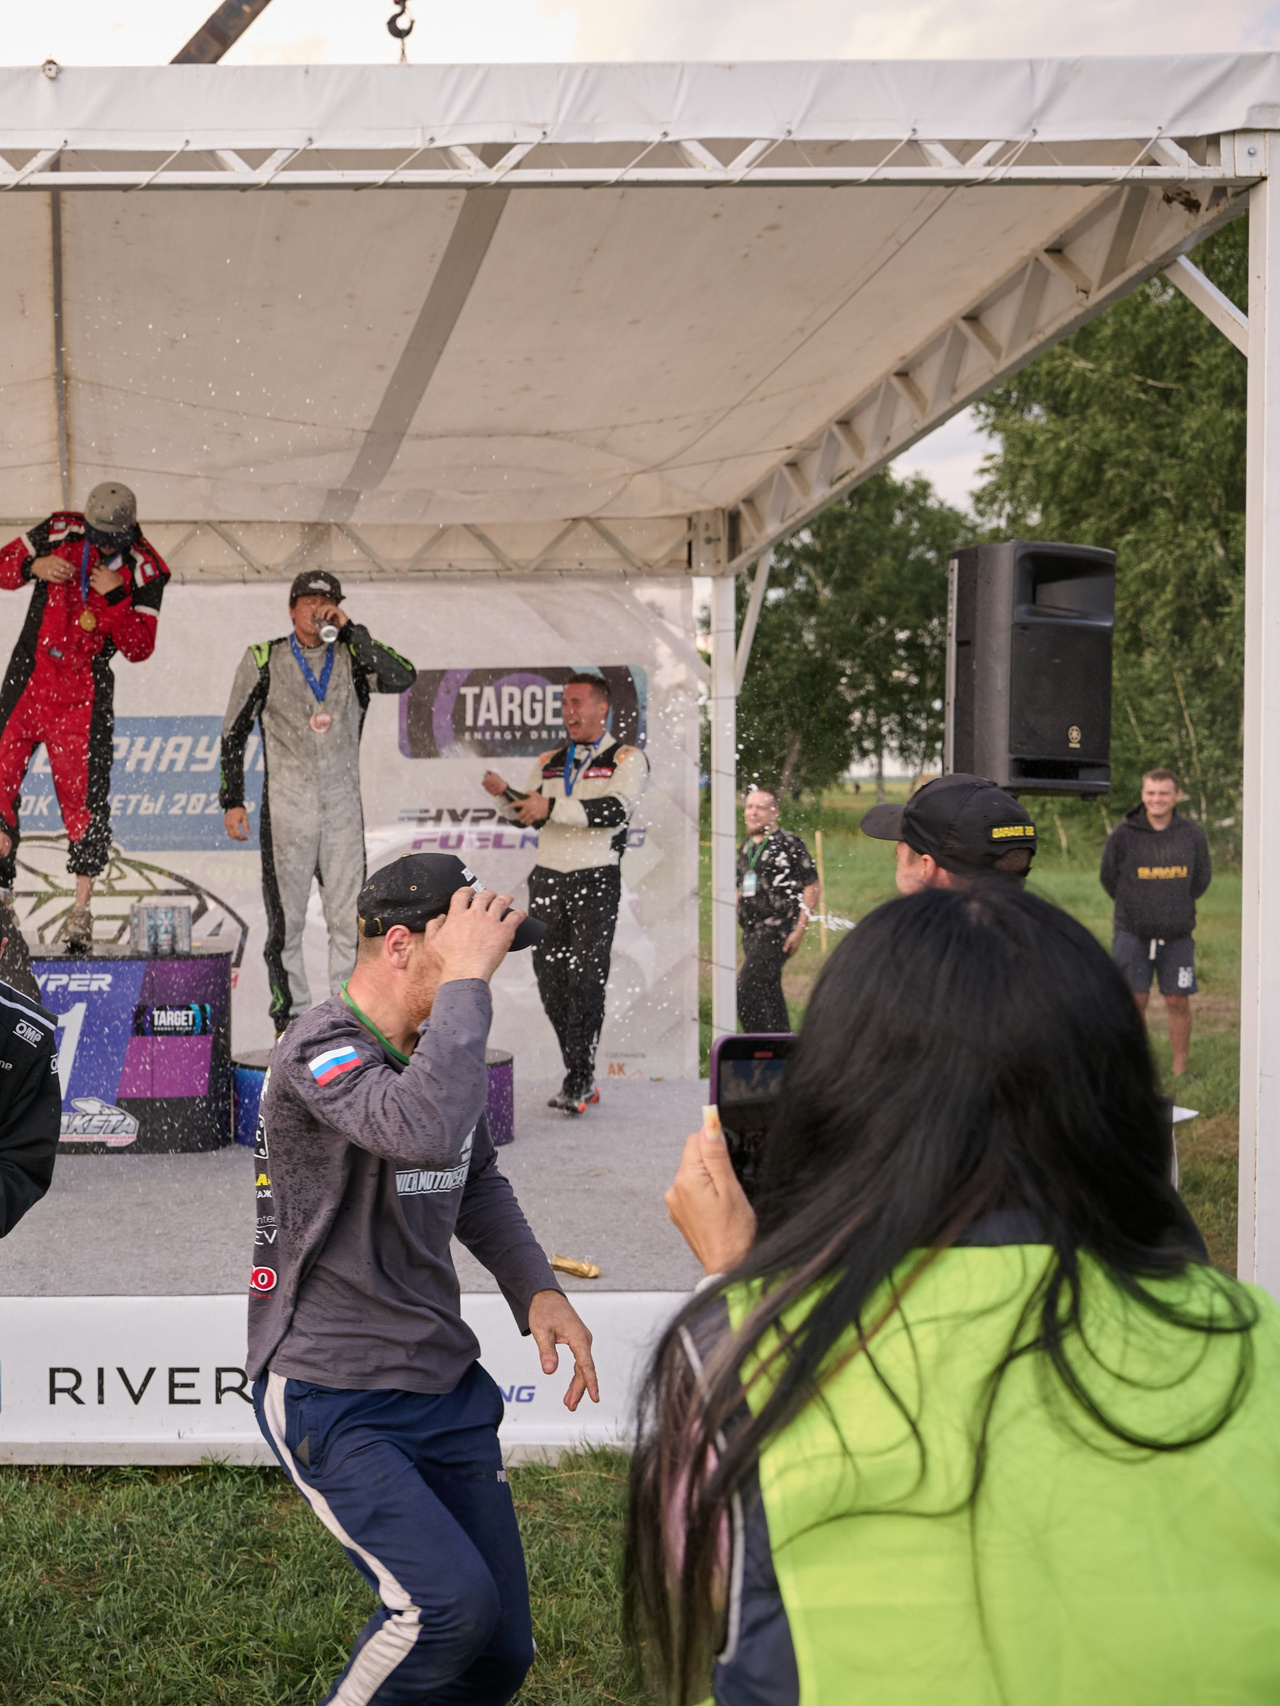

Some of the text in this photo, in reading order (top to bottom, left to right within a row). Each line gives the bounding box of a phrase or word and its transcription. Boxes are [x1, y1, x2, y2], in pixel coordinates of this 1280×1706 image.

[460, 685, 570, 727] TARGE
[464, 731, 574, 740] ENERGY DRIN
[168, 793, 225, 815] 202
[35, 973, 113, 992] YPER
[152, 1010, 195, 1026] TARGET
[15, 1023, 42, 1043] OMP
[57, 1002, 87, 1101] 1
[49, 1367, 254, 1405] RIVER
